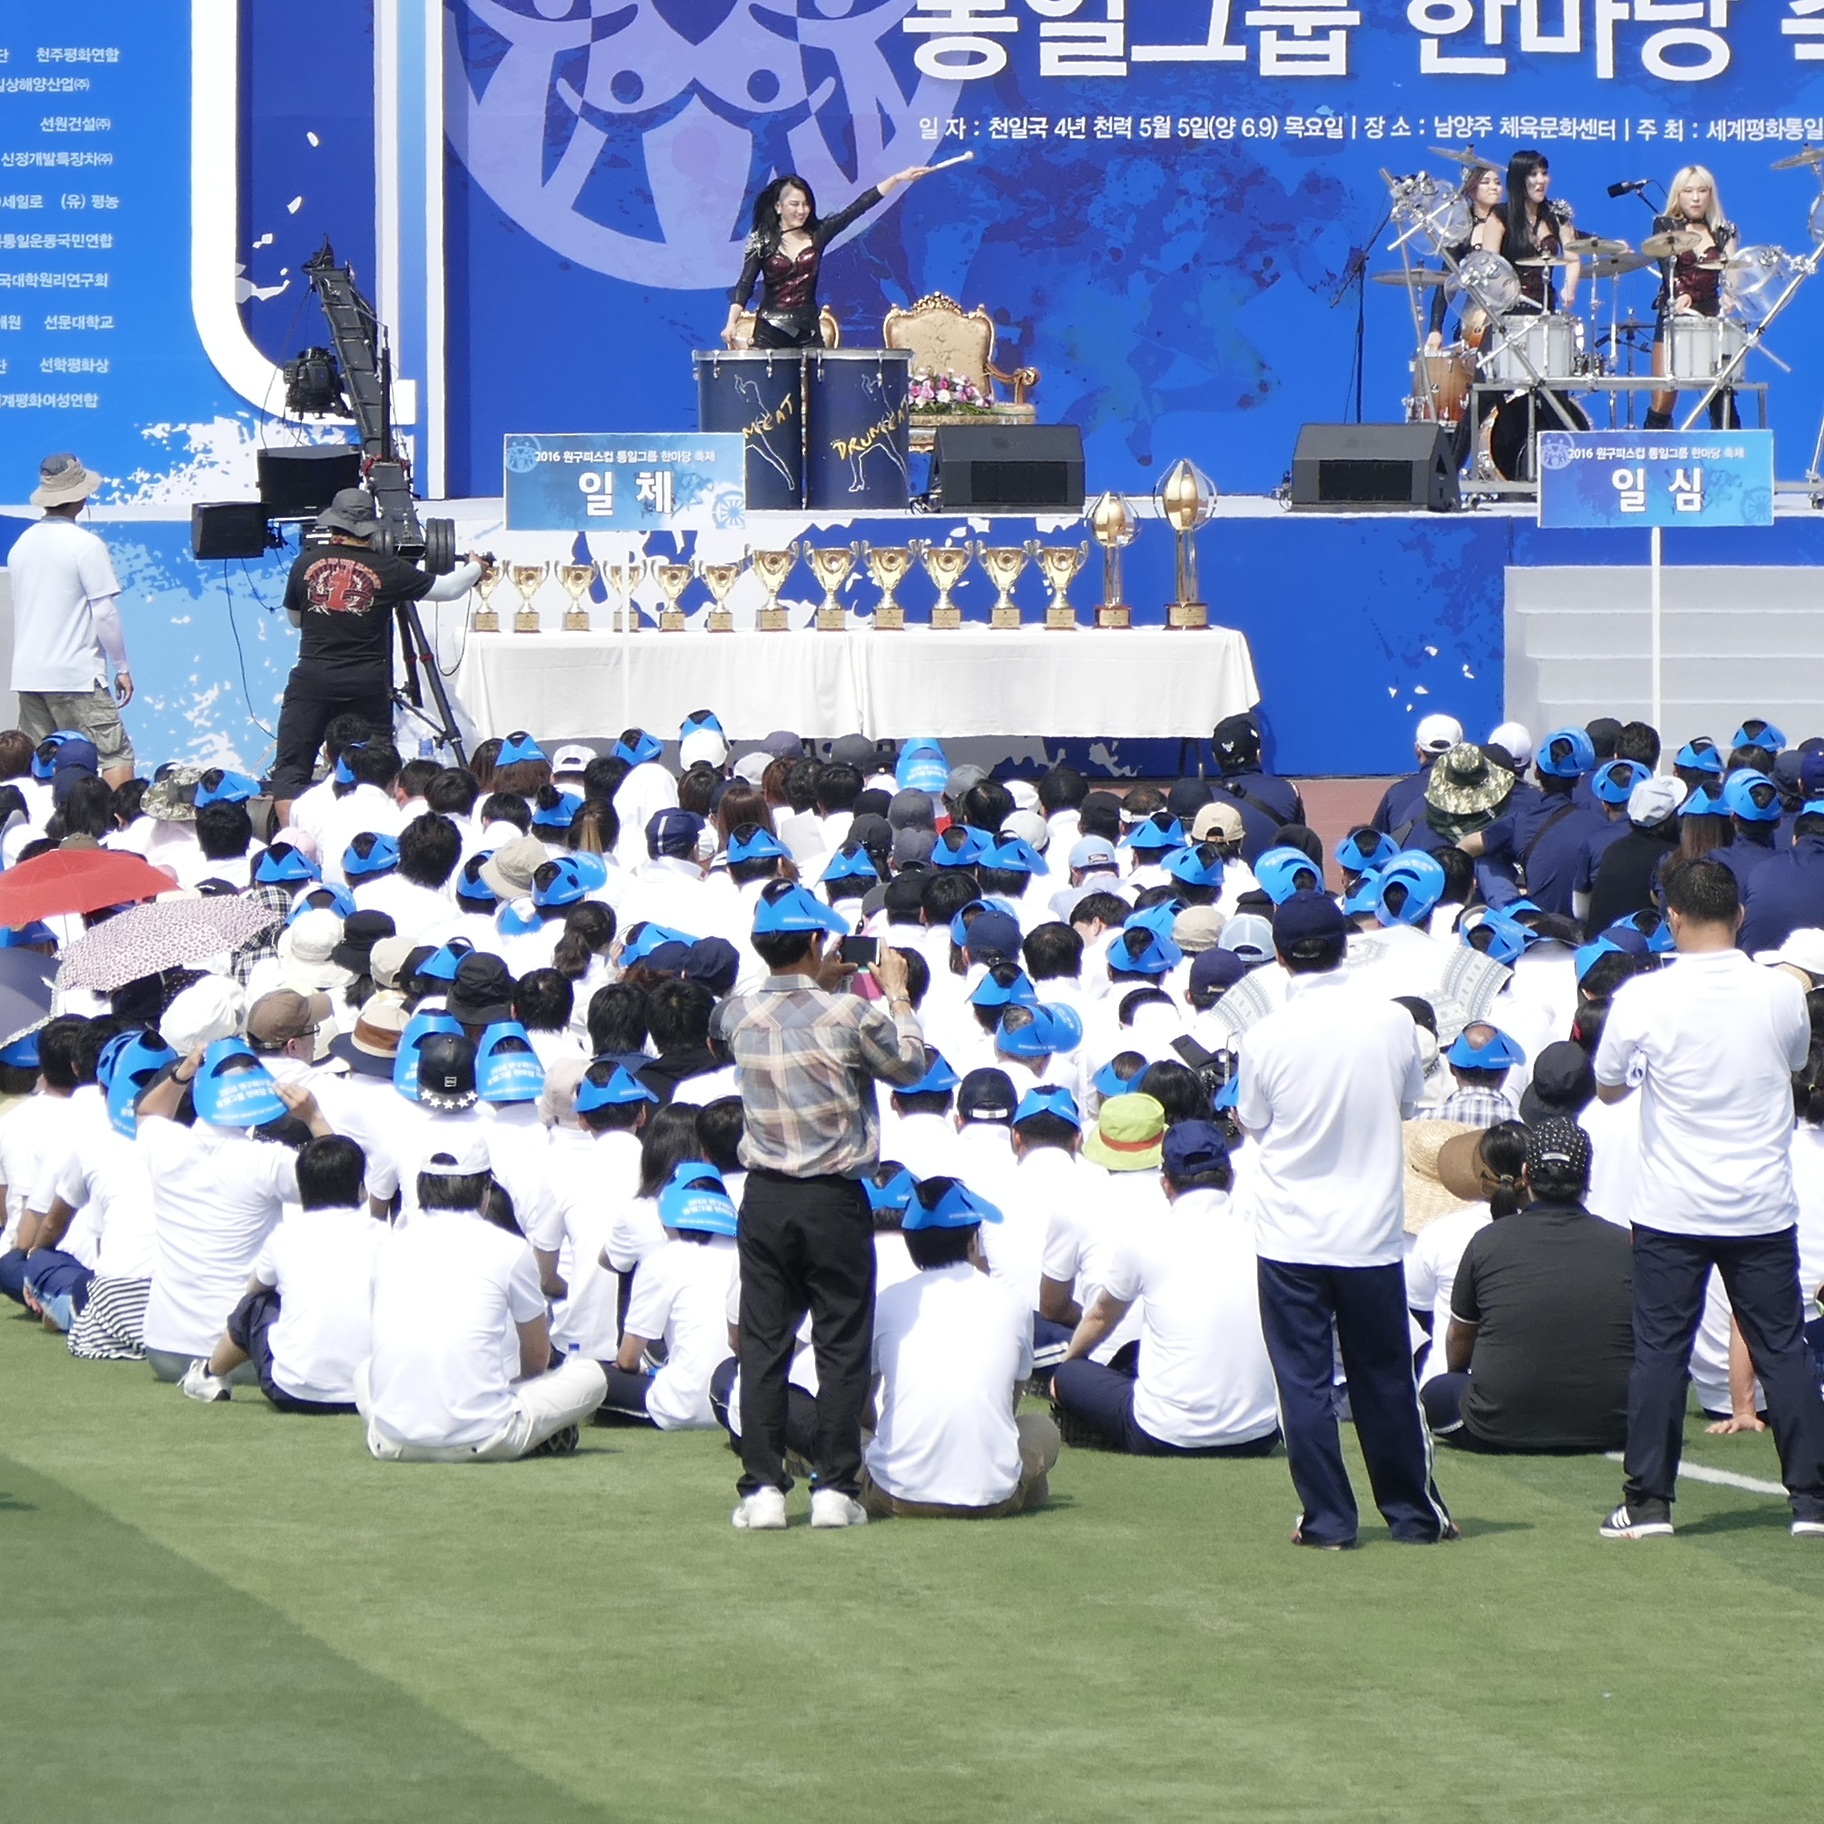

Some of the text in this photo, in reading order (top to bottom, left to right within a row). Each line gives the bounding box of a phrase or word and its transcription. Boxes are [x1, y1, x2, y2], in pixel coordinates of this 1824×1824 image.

[36, 47, 119, 63] 천주평화연합
[988, 117, 1047, 139] 천일국
[1054, 117, 1086, 139] 4년
[1093, 117, 1131, 139] 천력
[1139, 117, 1171, 139] 5월
[1177, 117, 1235, 140] 5일(양
[1241, 117, 1278, 140] 6.9)
[1284, 117, 1342, 140] 목요일
[1434, 116, 1493, 139] 남양주
[1499, 116, 1616, 140] 체육문화센터
[44, 314, 114, 330] 선문대학교
[39, 357, 109, 374] 선학평화상
